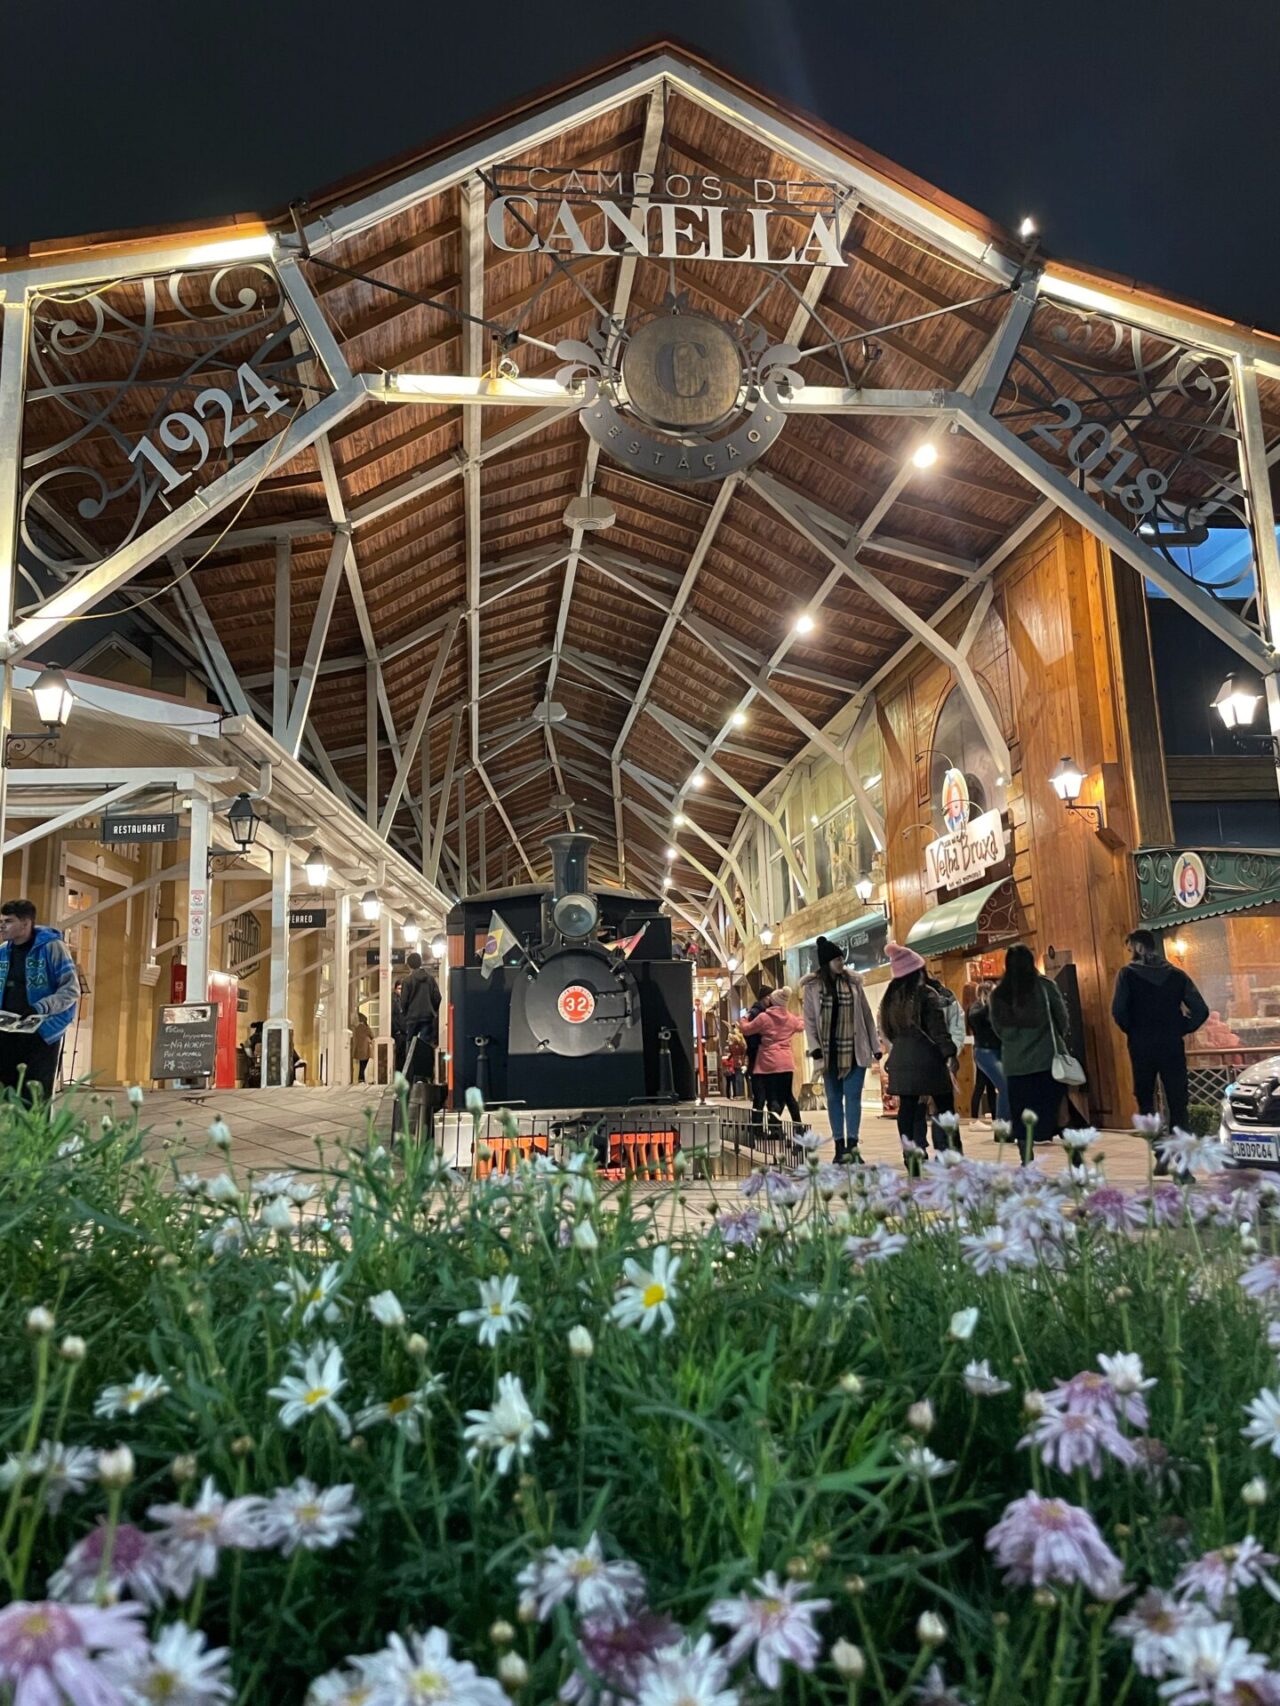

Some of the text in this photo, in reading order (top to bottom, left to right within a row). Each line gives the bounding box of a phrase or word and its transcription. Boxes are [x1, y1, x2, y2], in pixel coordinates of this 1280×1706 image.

[528, 167, 804, 204] CAMPOS DE
[487, 194, 848, 267] CANELLA
[128, 362, 290, 495] 1924
[608, 427, 762, 471] ESTAÇÃO
[1031, 396, 1168, 514] 2018
[113, 823, 166, 835] RESTAURANTE
[566, 997, 587, 1012] 32
